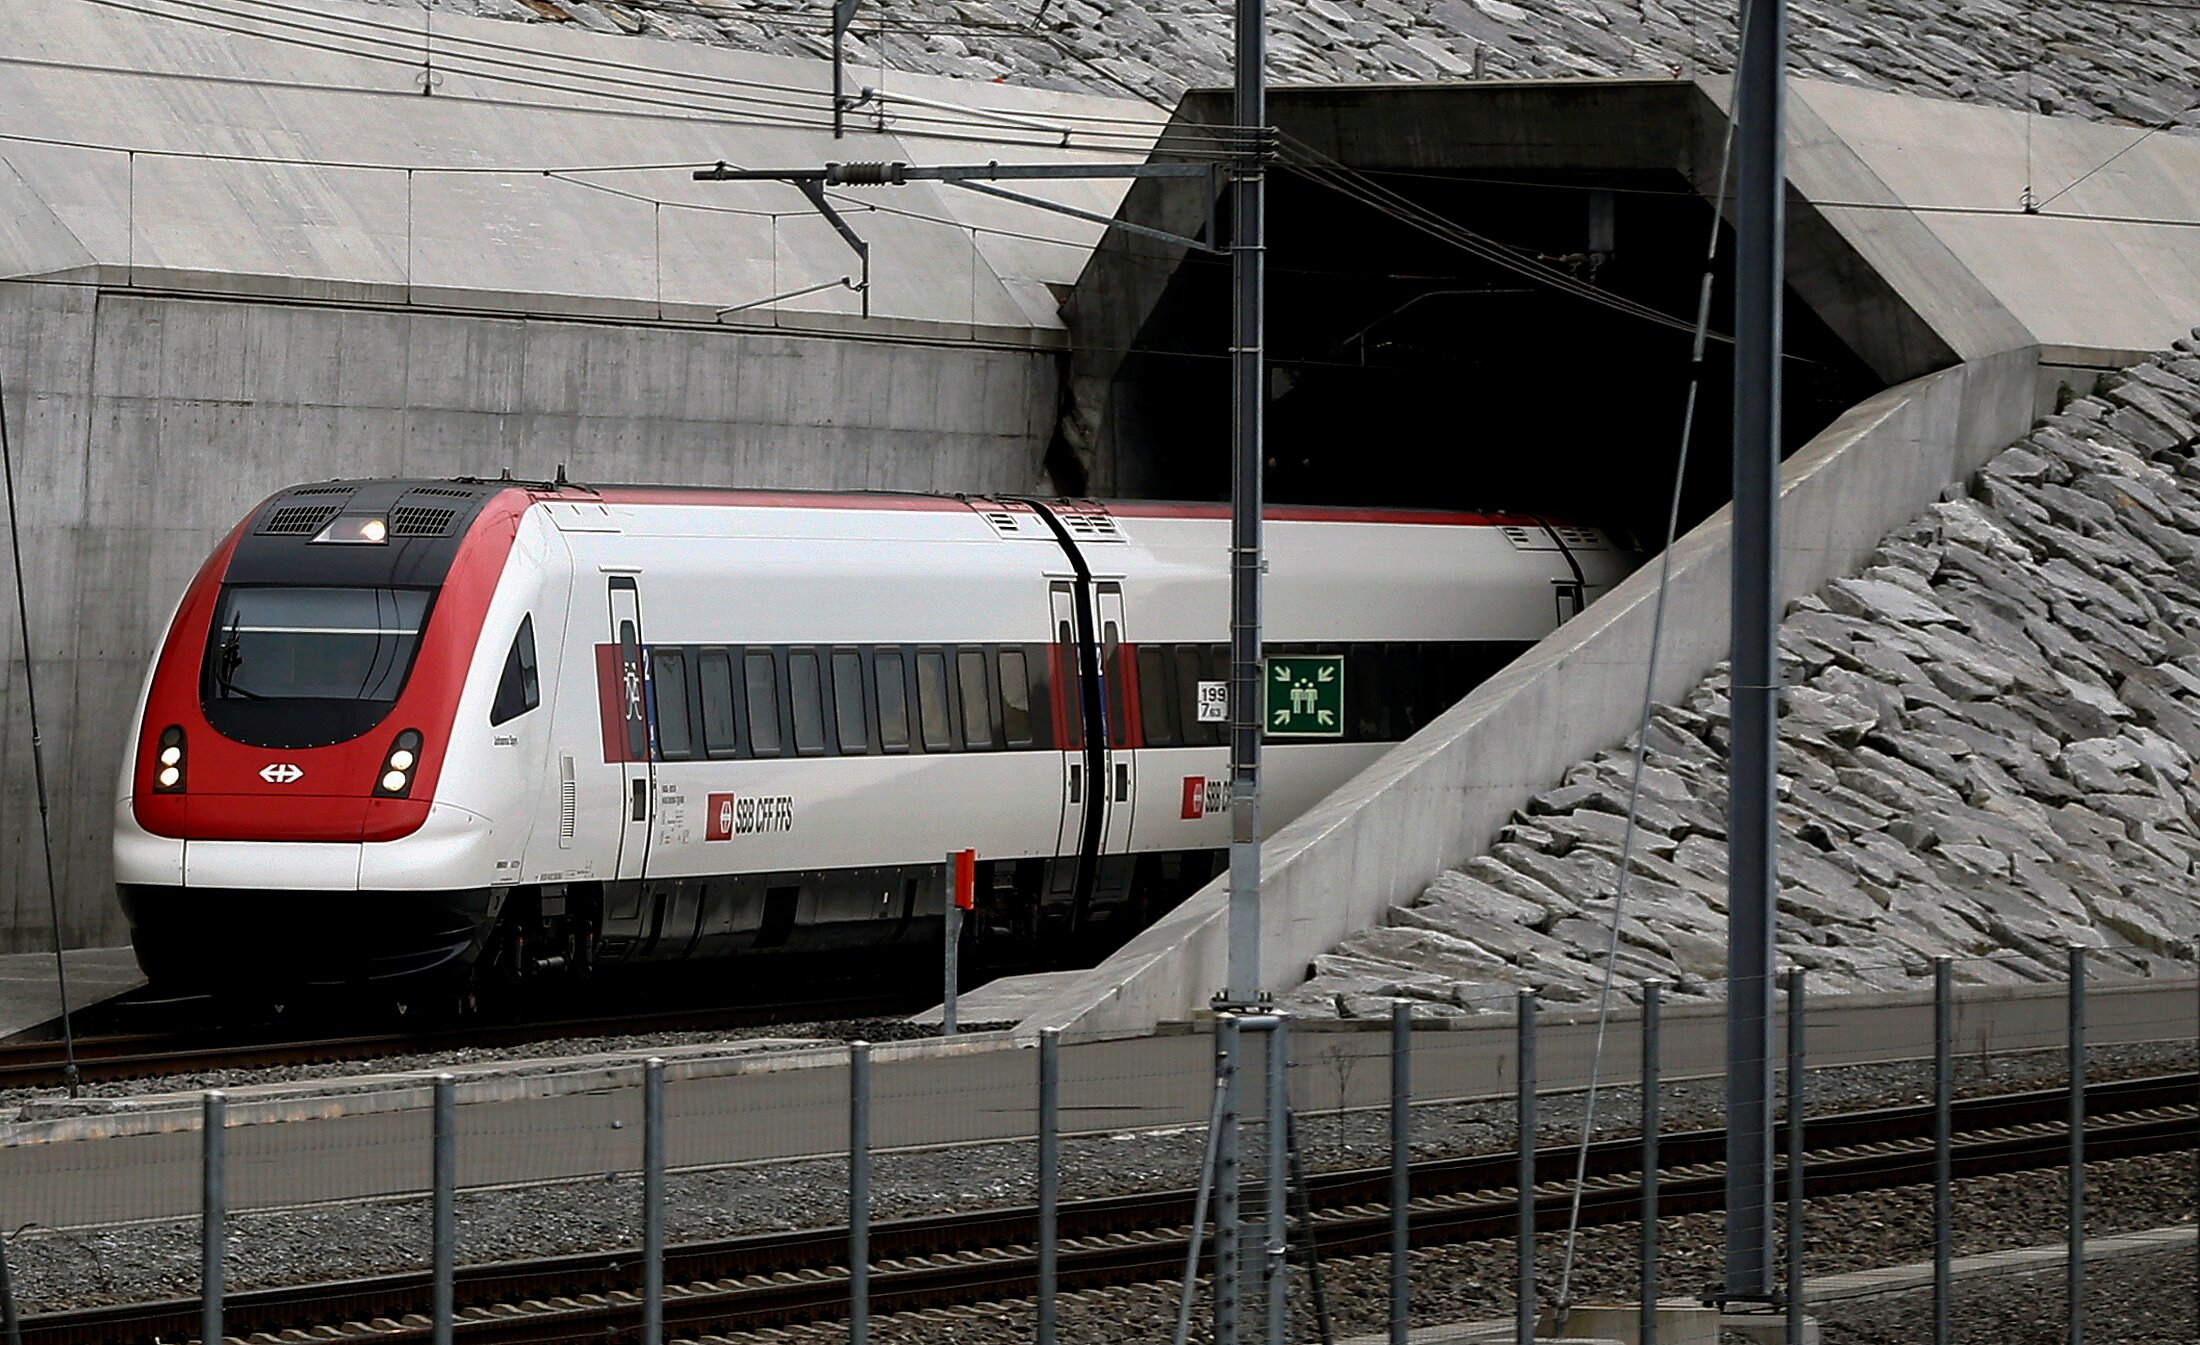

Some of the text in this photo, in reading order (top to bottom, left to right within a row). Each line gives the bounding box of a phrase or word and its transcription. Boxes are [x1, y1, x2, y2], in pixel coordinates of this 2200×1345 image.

[643, 649, 650, 680] 2
[1202, 687, 1226, 702] 199
[1205, 781, 1221, 812] SBB
[735, 796, 793, 833] SBB CFF FFS
